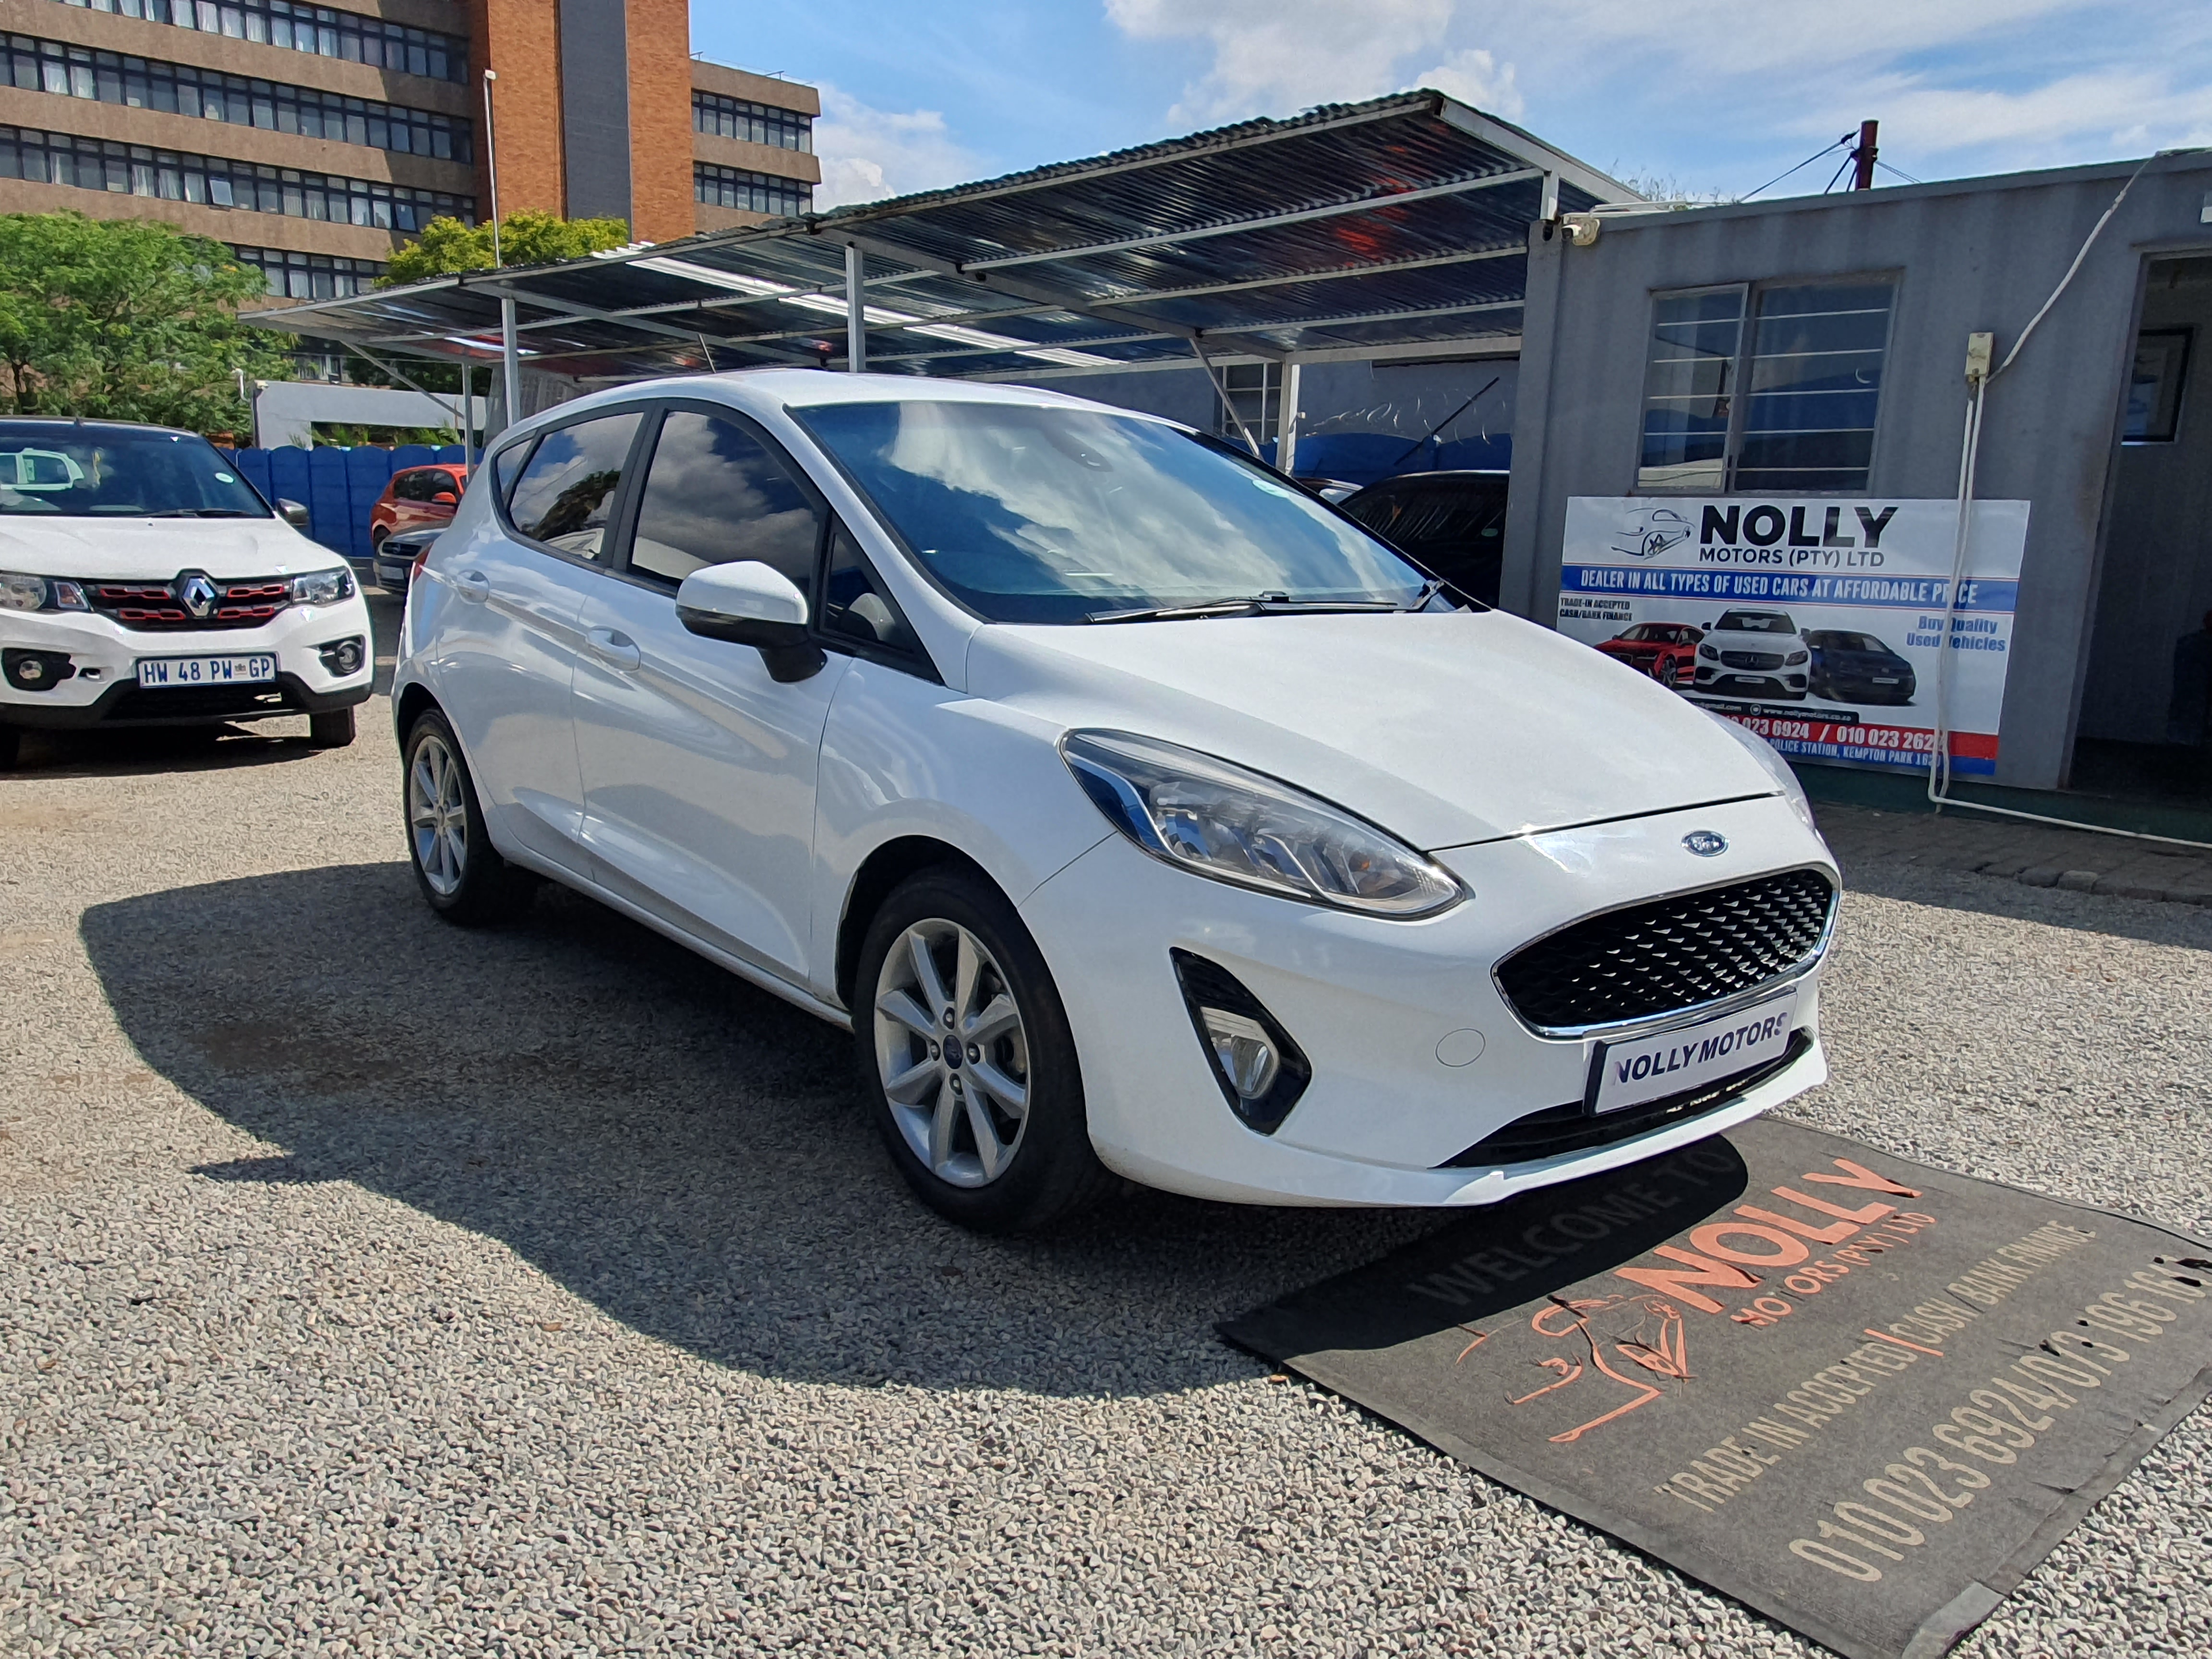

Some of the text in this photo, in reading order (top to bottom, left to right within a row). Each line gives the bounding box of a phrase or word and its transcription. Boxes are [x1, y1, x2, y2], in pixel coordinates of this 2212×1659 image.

[1700, 505, 1899, 548] NOLLY
[1699, 548, 1884, 568] MOTORS (PTY) LTD
[1581, 570, 1978, 603] DEALER IN ALL TYPES OF USED CARS AT AFFORDABLE PRCE
[1561, 598, 1630, 610] TRADE-IN ACCEPTED
[1603, 611, 1633, 621] FINANCE
[1918, 615, 1944, 631] Buy
[1906, 633, 1940, 648] Used
[144, 658, 270, 683] HW 48 PW GP
[1772, 720, 1809, 739] 6924
[1818, 724, 1830, 742] /
[1837, 726, 1865, 744] 010
[1868, 729, 1899, 747] 023
[1902, 732, 1945, 752] 262
[1802, 742, 1840, 758] STATION,
[1843, 746, 1886, 762] KEMPTON
[1888, 750, 1914, 764] PARK
[1406, 1149, 1737, 1306] WELCOME TO
[1614, 1157, 1923, 1314] NOLLY
[1996, 1220, 2097, 1268] FINANCE
[1772, 1342, 1918, 1429] ACCEPTED
[1741, 1416, 1812, 1450] IN
[1654, 1434, 1782, 1512] TRADE
[1789, 1501, 1925, 1581] 010
[1863, 1446, 1991, 1523] 023
